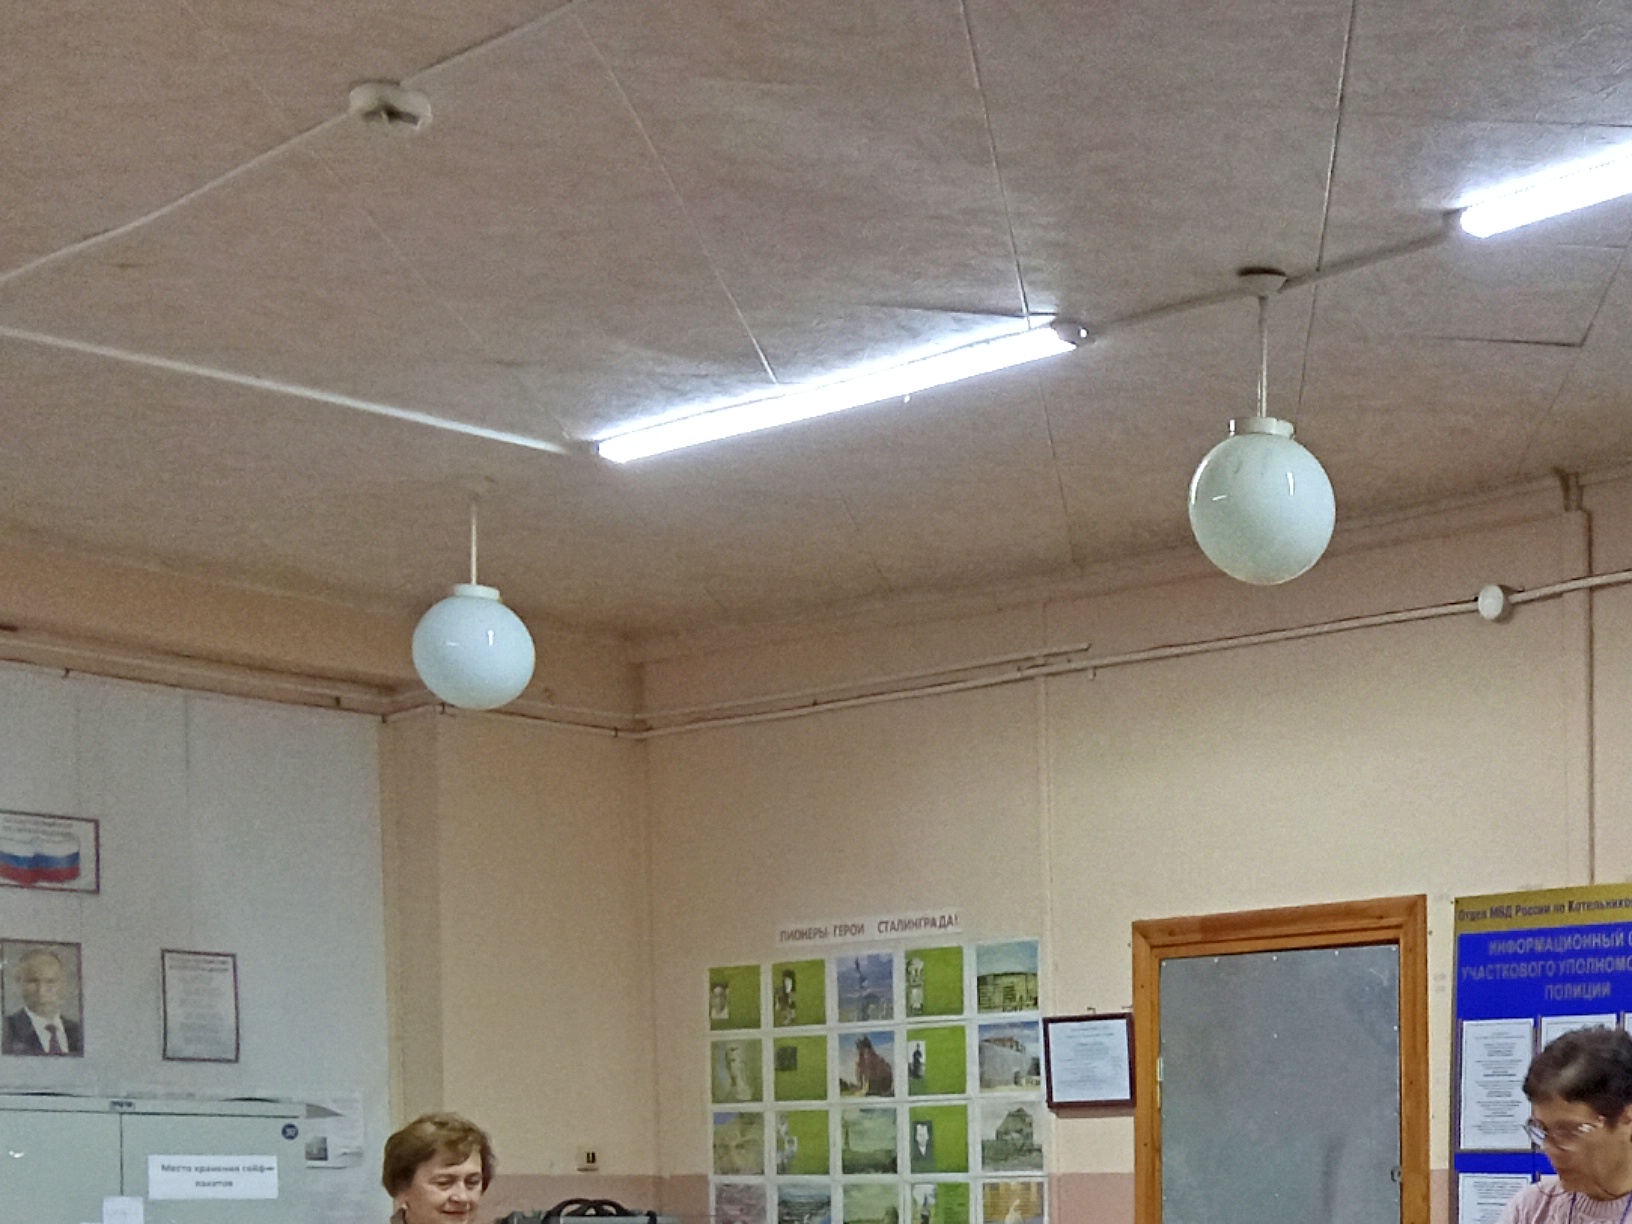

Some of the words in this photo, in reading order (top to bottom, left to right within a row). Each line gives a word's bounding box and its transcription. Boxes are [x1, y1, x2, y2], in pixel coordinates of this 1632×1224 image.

[1515, 904, 1550, 917] России
[833, 923, 865, 937] ГЕРОИ
[1489, 928, 1624, 955] ИНФОРМАЦИОННЫЙ
[1461, 961, 1556, 981] УЧАСТКОВОГО
[1544, 981, 1612, 1001] ПОЛИЦИИ
